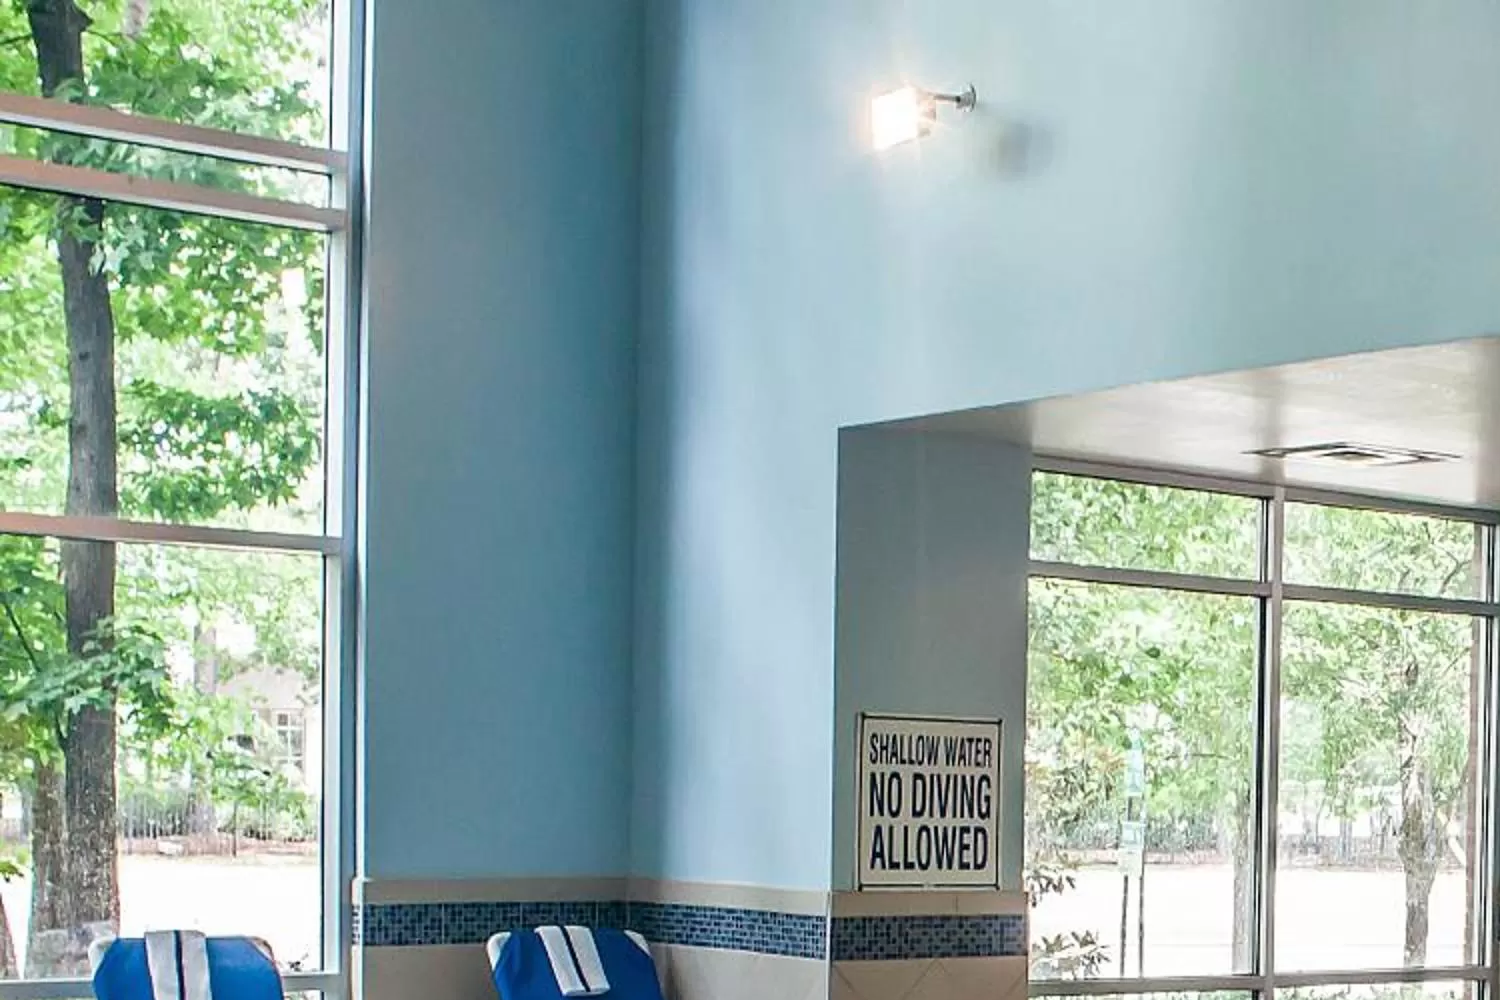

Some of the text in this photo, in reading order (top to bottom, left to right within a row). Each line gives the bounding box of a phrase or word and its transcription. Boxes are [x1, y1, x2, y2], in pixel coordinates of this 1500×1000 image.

[869, 733, 993, 768] SHALLOW WATER
[869, 771, 992, 820] NO DIVING
[869, 824, 989, 871] ALLOWED
